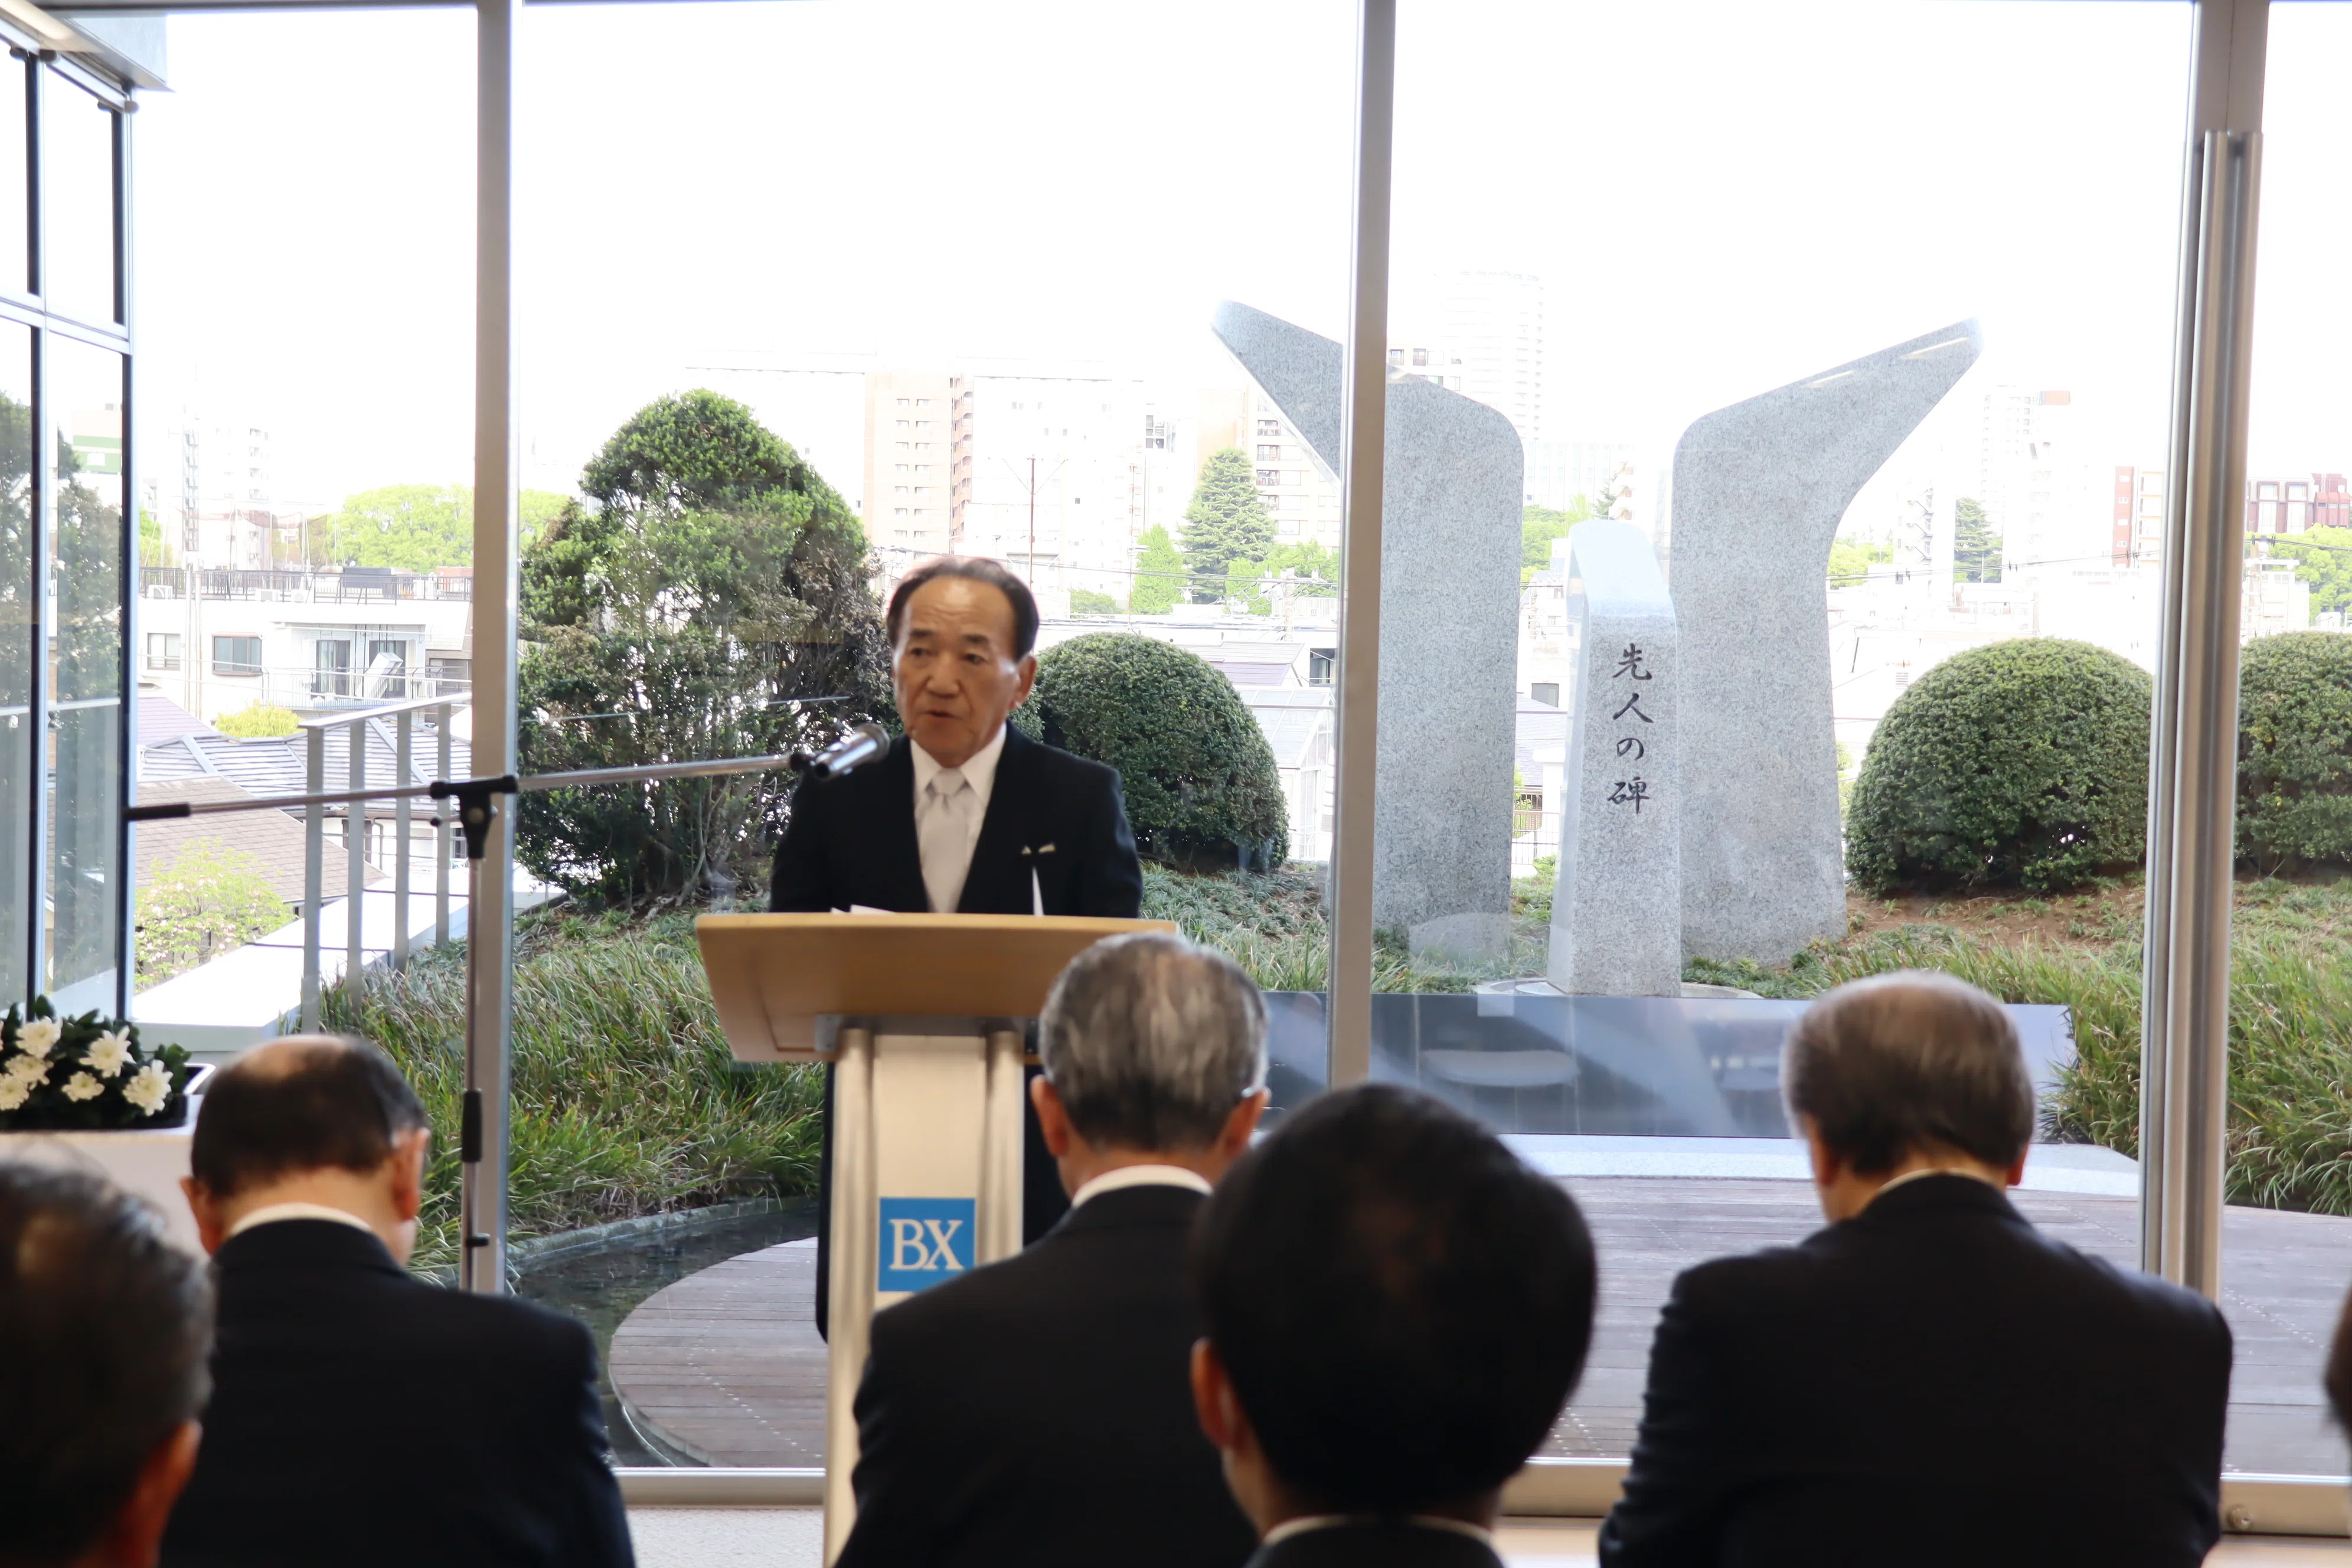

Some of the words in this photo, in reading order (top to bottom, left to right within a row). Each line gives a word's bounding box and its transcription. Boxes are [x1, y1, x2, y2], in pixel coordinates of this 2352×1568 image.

[1607, 643, 1654, 815] 先人の碑
[888, 1219, 965, 1270] BX
